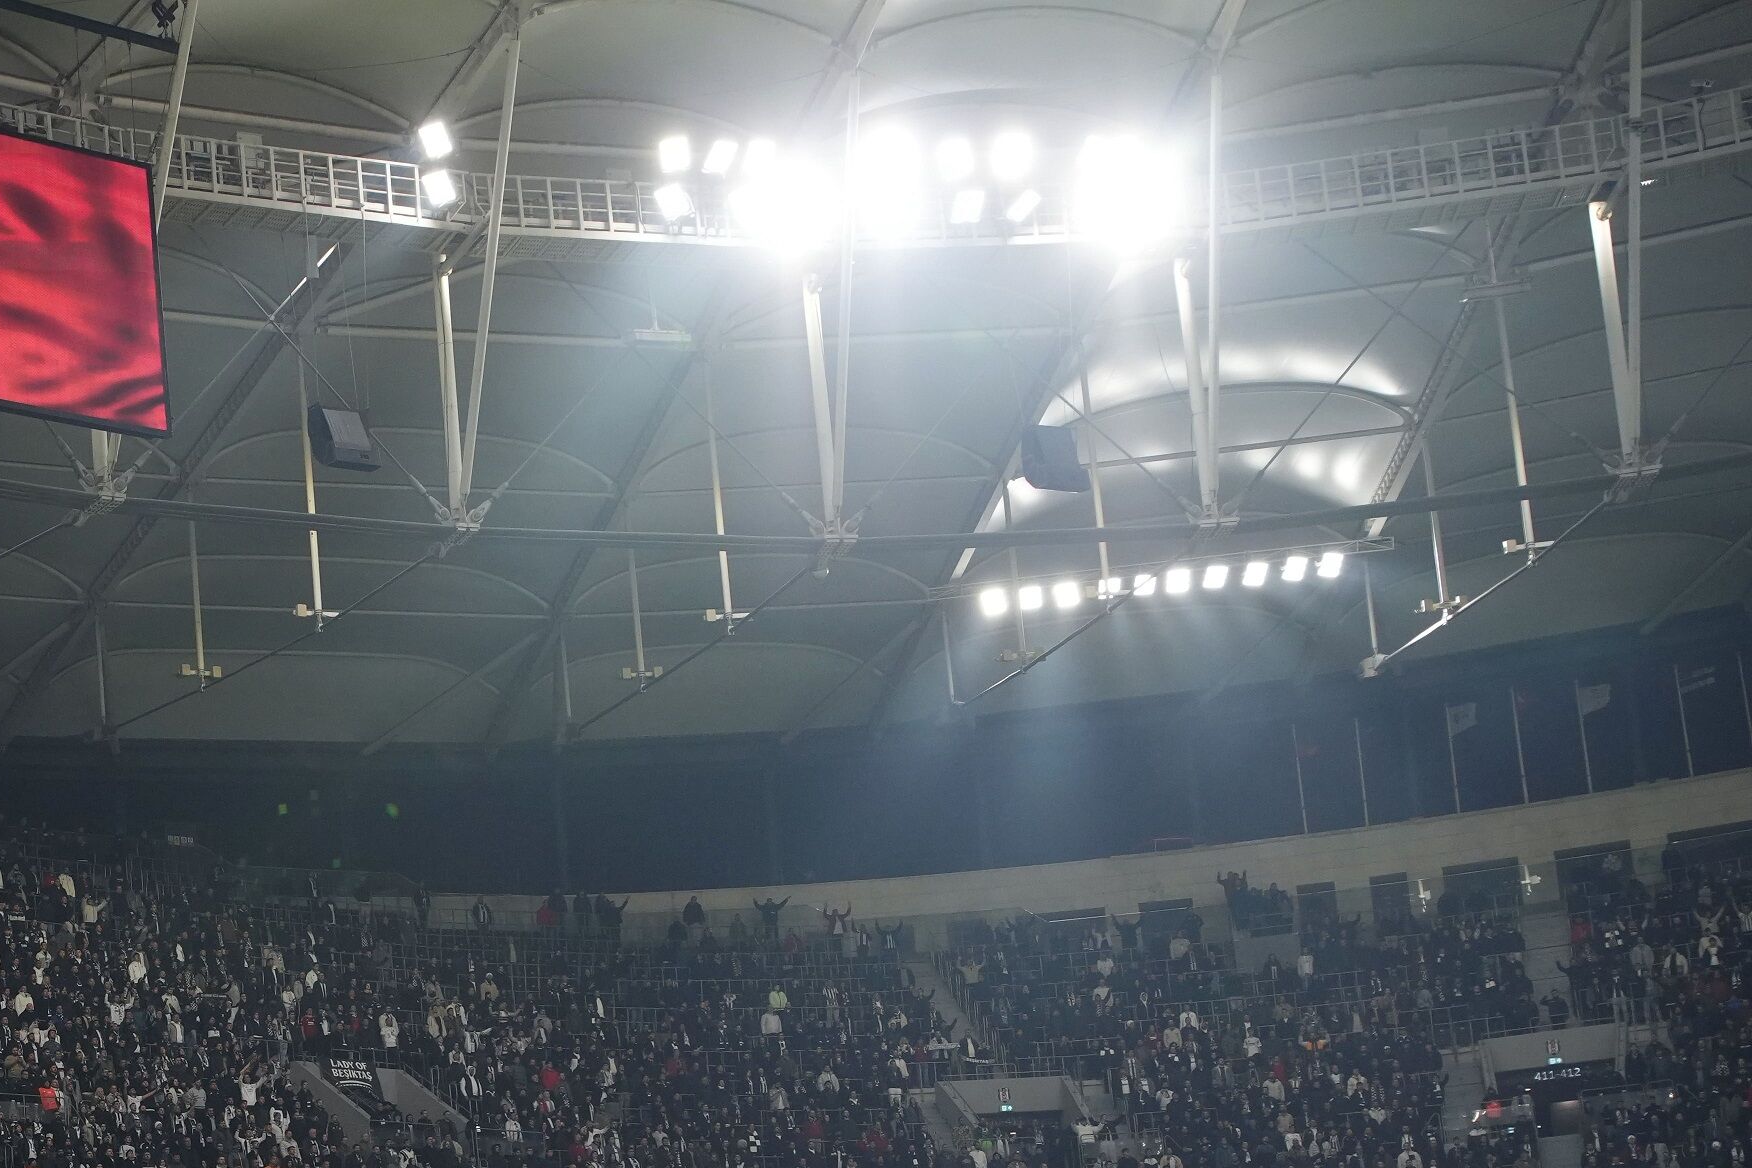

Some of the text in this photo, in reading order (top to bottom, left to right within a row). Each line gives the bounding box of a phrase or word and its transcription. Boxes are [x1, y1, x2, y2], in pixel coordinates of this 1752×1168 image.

[330, 1059, 367, 1070] LADY OF
[1534, 1067, 1582, 1081] 411-412
